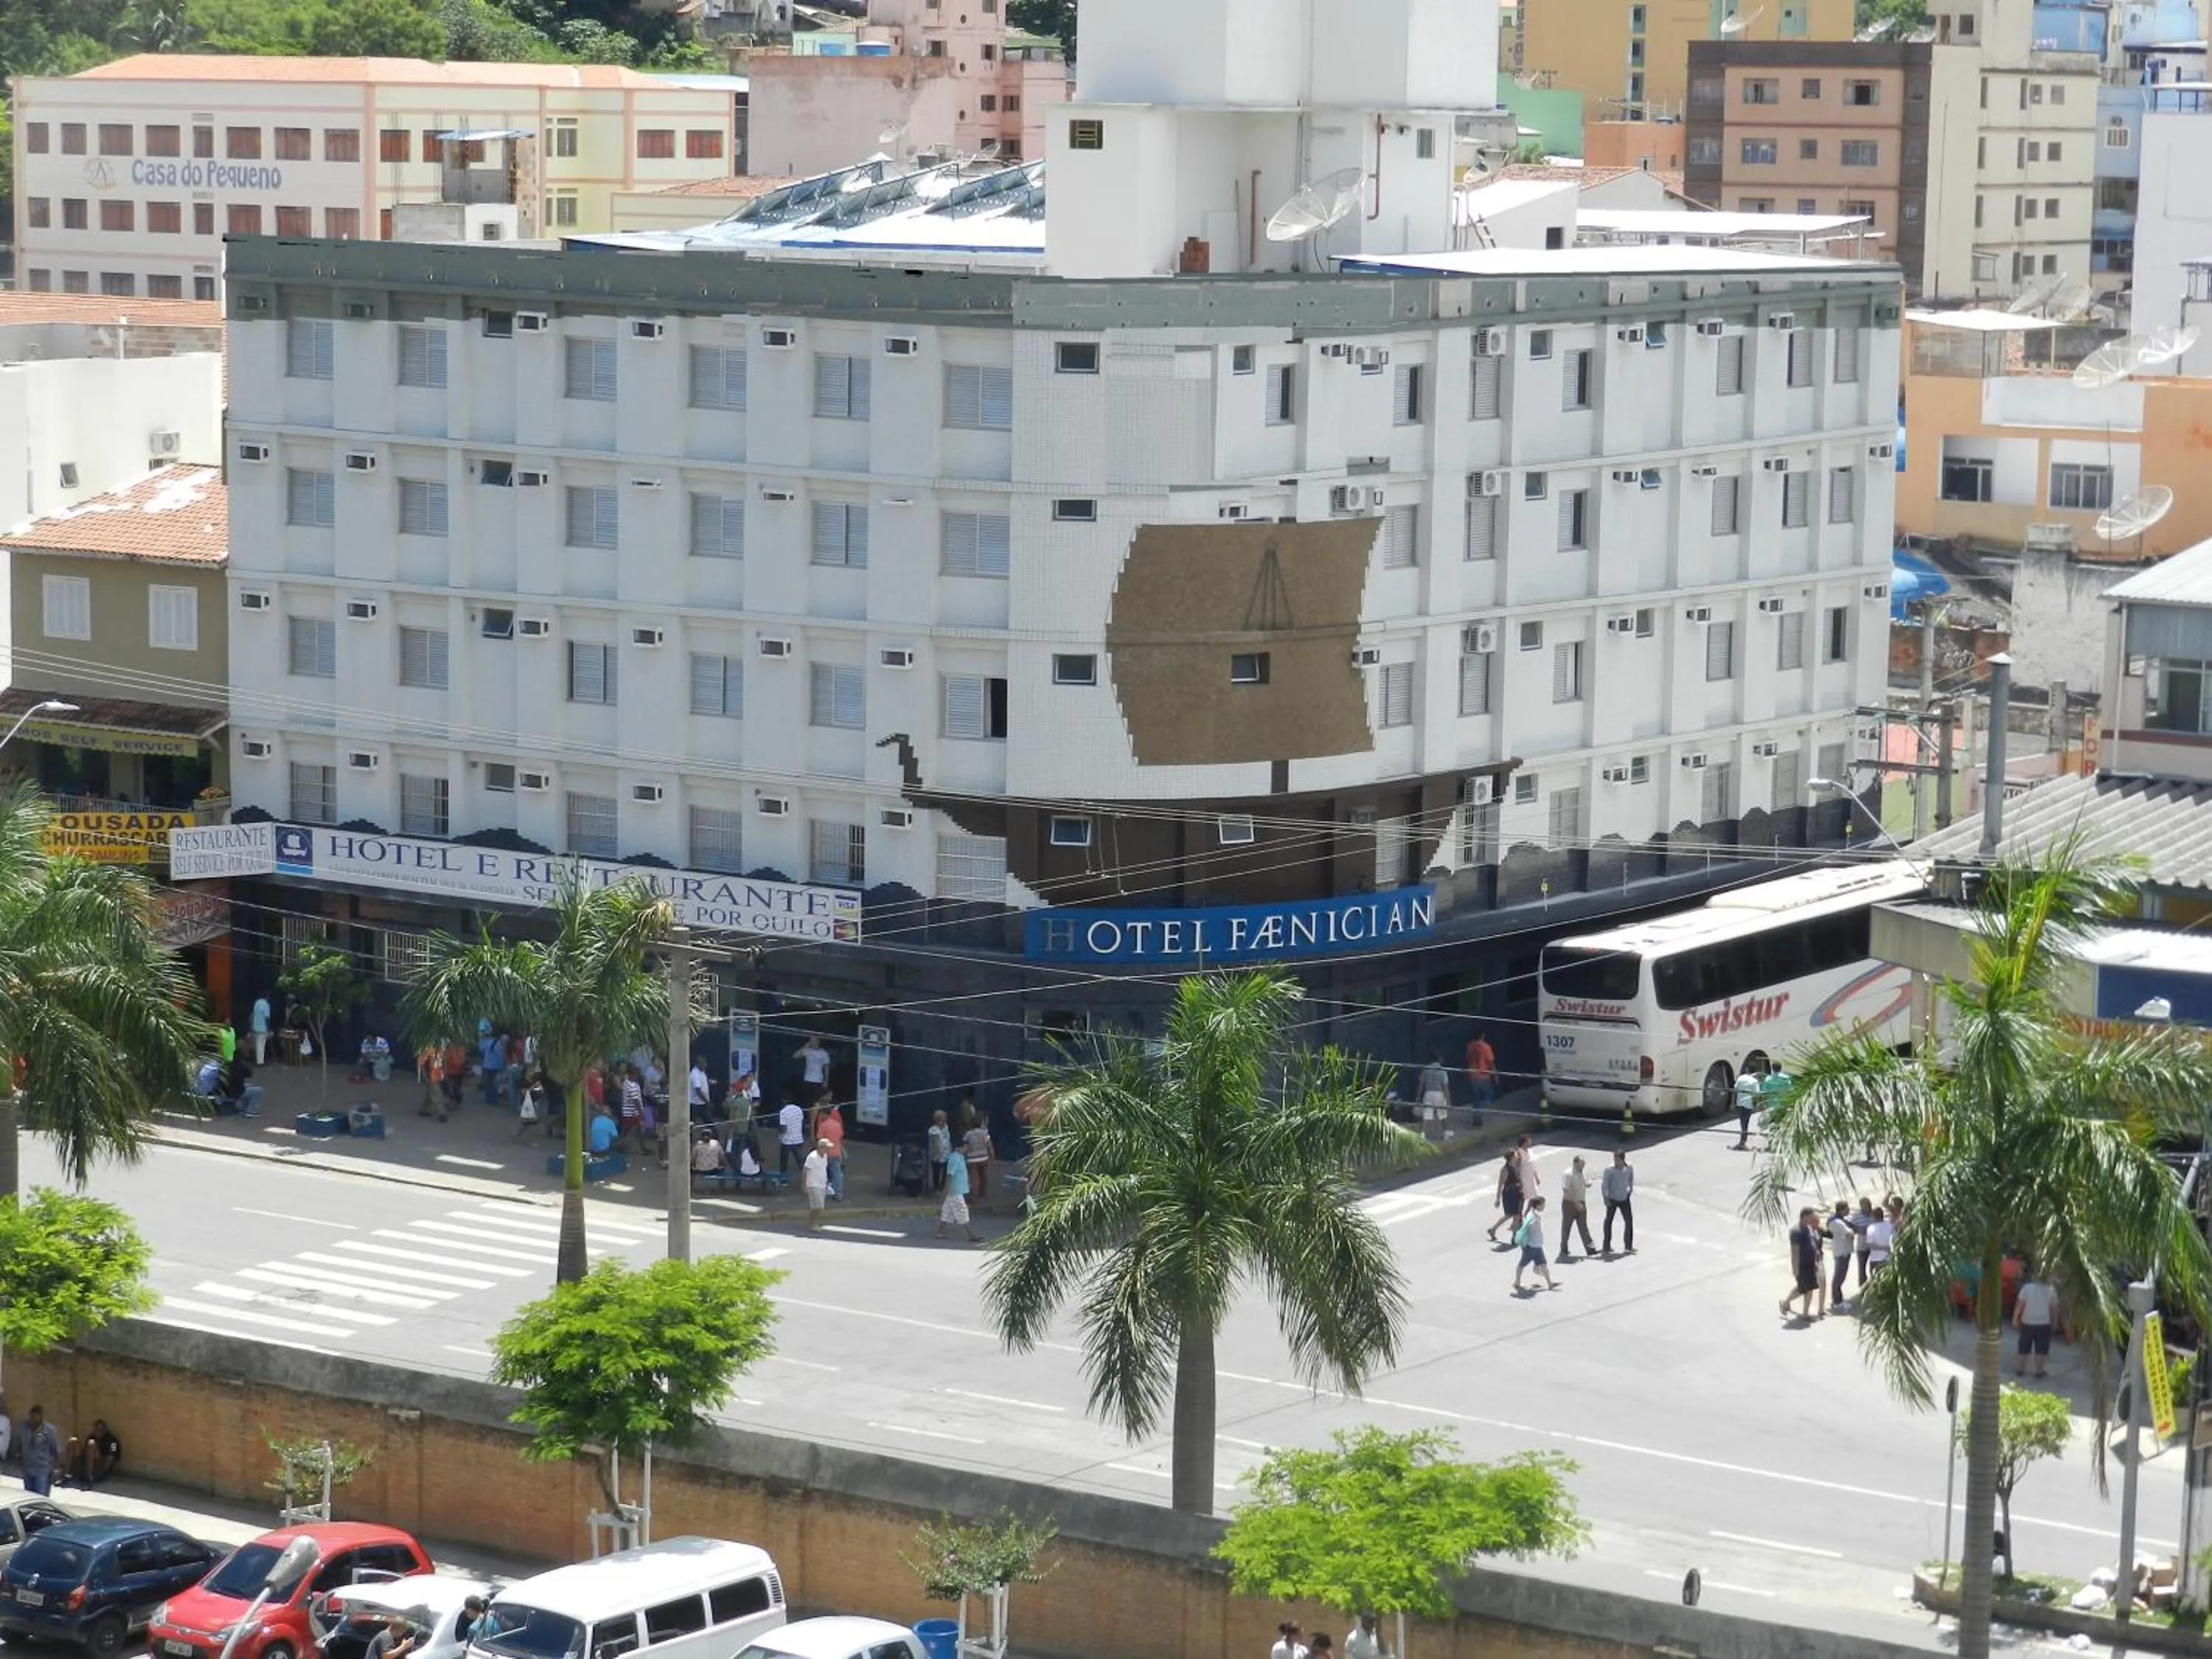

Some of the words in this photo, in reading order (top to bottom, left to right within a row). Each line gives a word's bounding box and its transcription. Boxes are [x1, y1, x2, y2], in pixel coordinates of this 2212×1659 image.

[131, 159, 177, 186] Casa
[181, 159, 203, 187] do
[207, 160, 282, 189] Pequeno
[112, 739, 184, 751] SERVICE
[52, 814, 185, 830] OUSADA
[175, 827, 267, 852] RESTAURANTE
[330, 835, 462, 872] HOTEL
[476, 852, 500, 877] E
[696, 906, 742, 927] POR
[752, 914, 831, 938] QUILO
[1043, 918, 1211, 956] HOTEL
[1554, 998, 1626, 1015] Swistur
[1680, 991, 1790, 1038] Swistur
[1546, 1034, 1576, 1048] 1307
